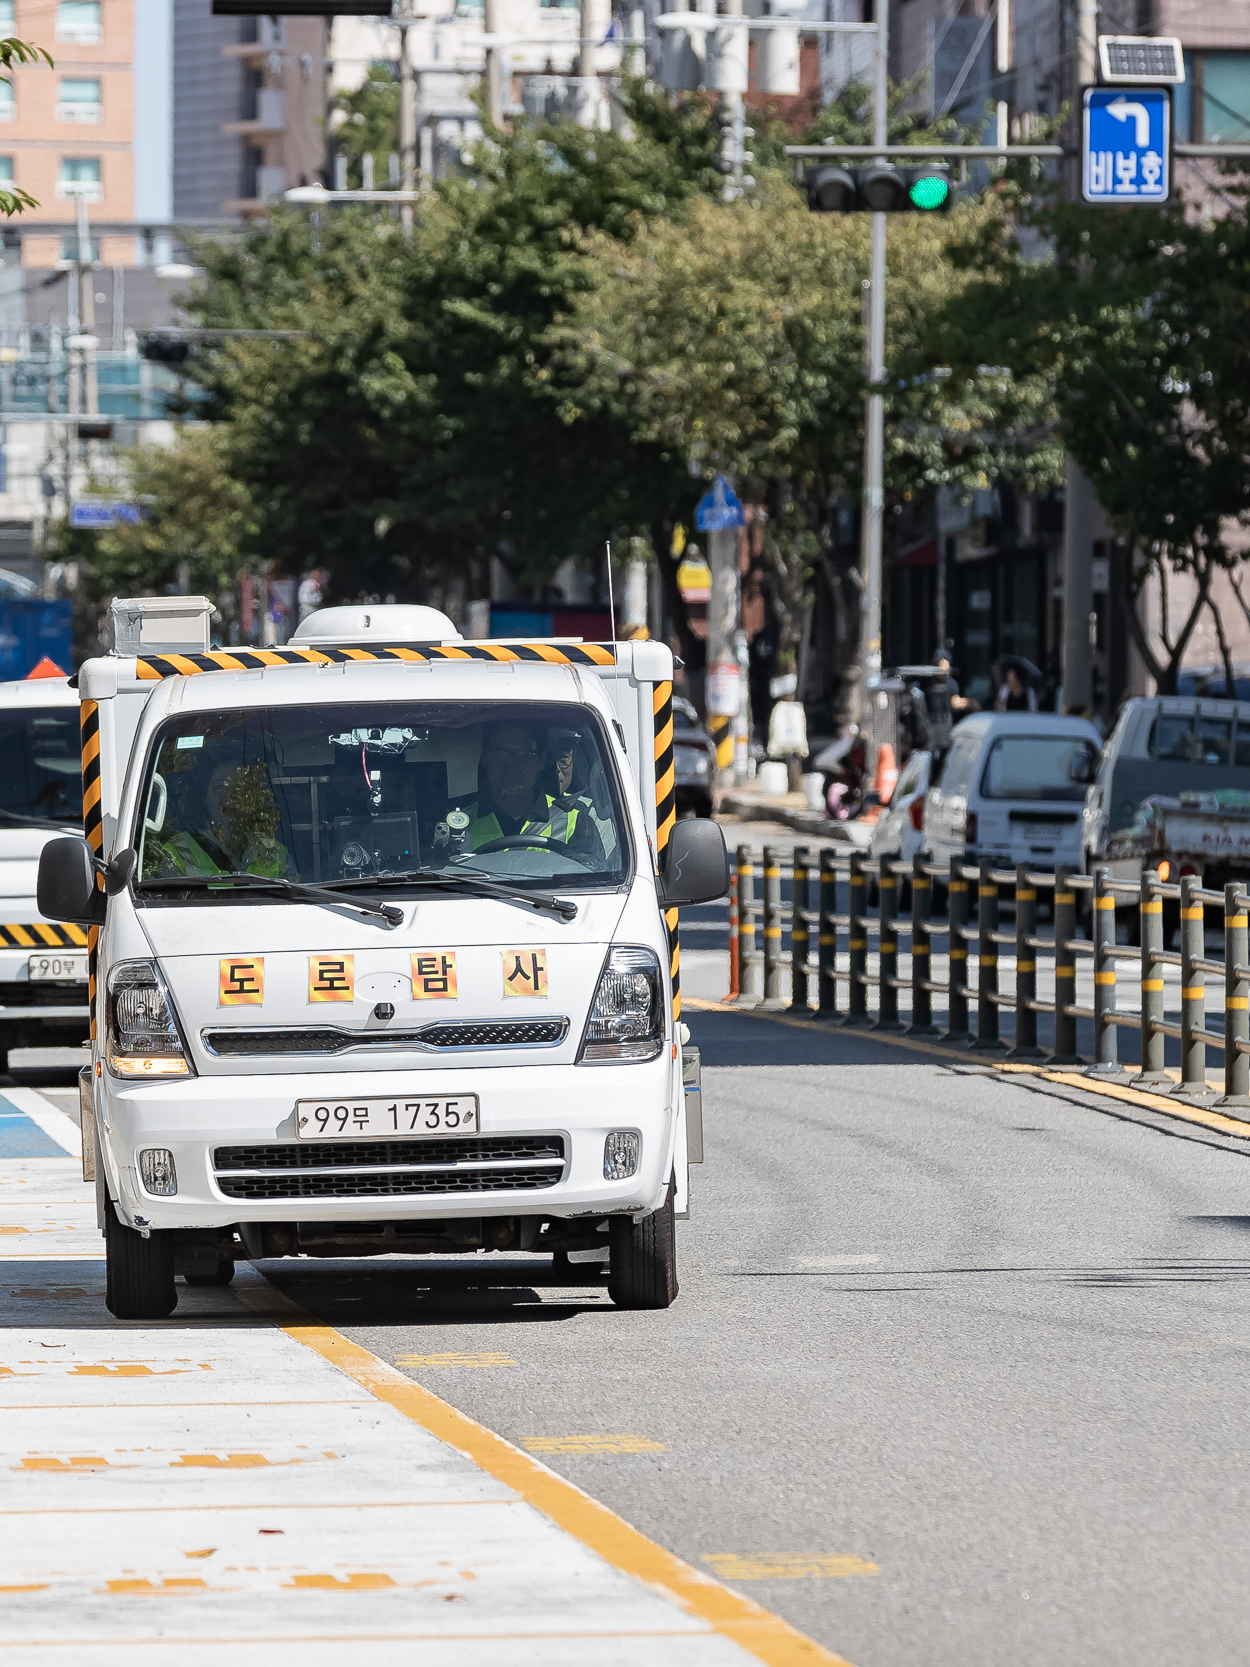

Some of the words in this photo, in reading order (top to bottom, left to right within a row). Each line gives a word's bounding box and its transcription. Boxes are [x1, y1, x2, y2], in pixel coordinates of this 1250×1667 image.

[1090, 151, 1162, 193] 비보호
[314, 1105, 371, 1133] 99무
[387, 1101, 461, 1131] 1735
